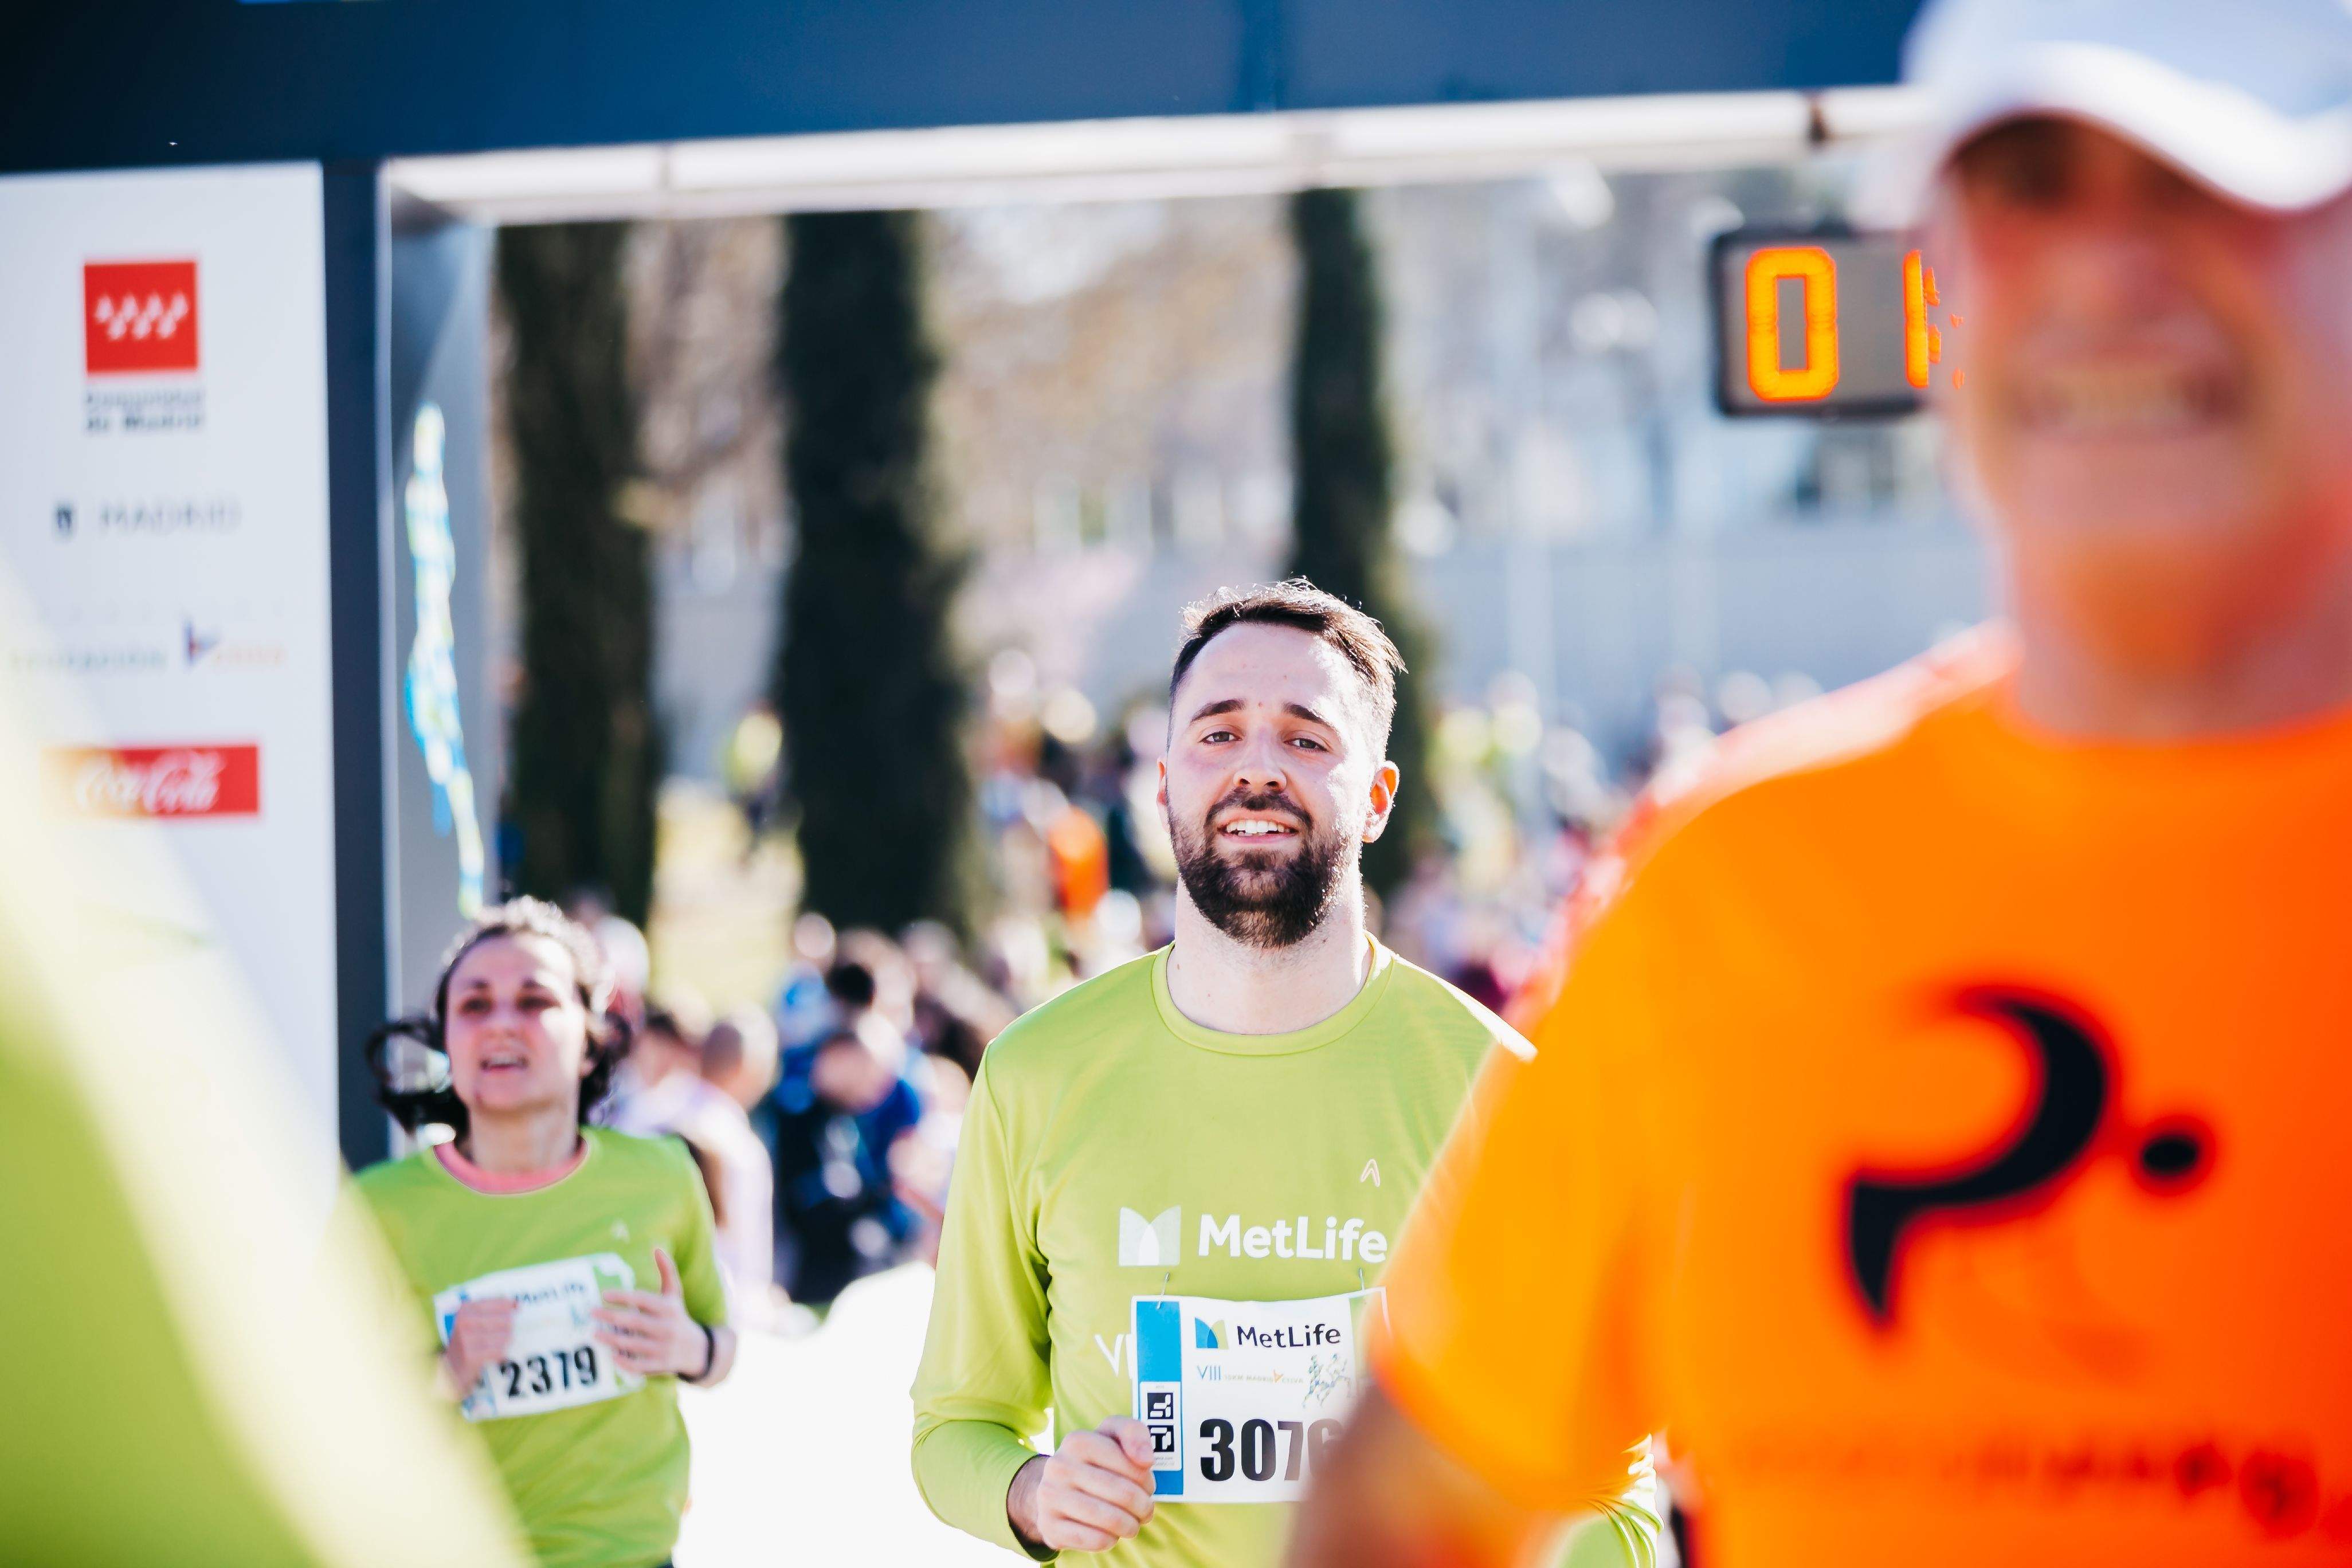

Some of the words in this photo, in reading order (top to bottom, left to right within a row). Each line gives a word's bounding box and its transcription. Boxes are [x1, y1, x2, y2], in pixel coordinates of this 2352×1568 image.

[1198, 1213, 1388, 1264] MetLife
[1237, 1323, 1341, 1349] MetLife
[499, 1344, 598, 1399] 2379
[1197, 1365, 1222, 1381] VIII
